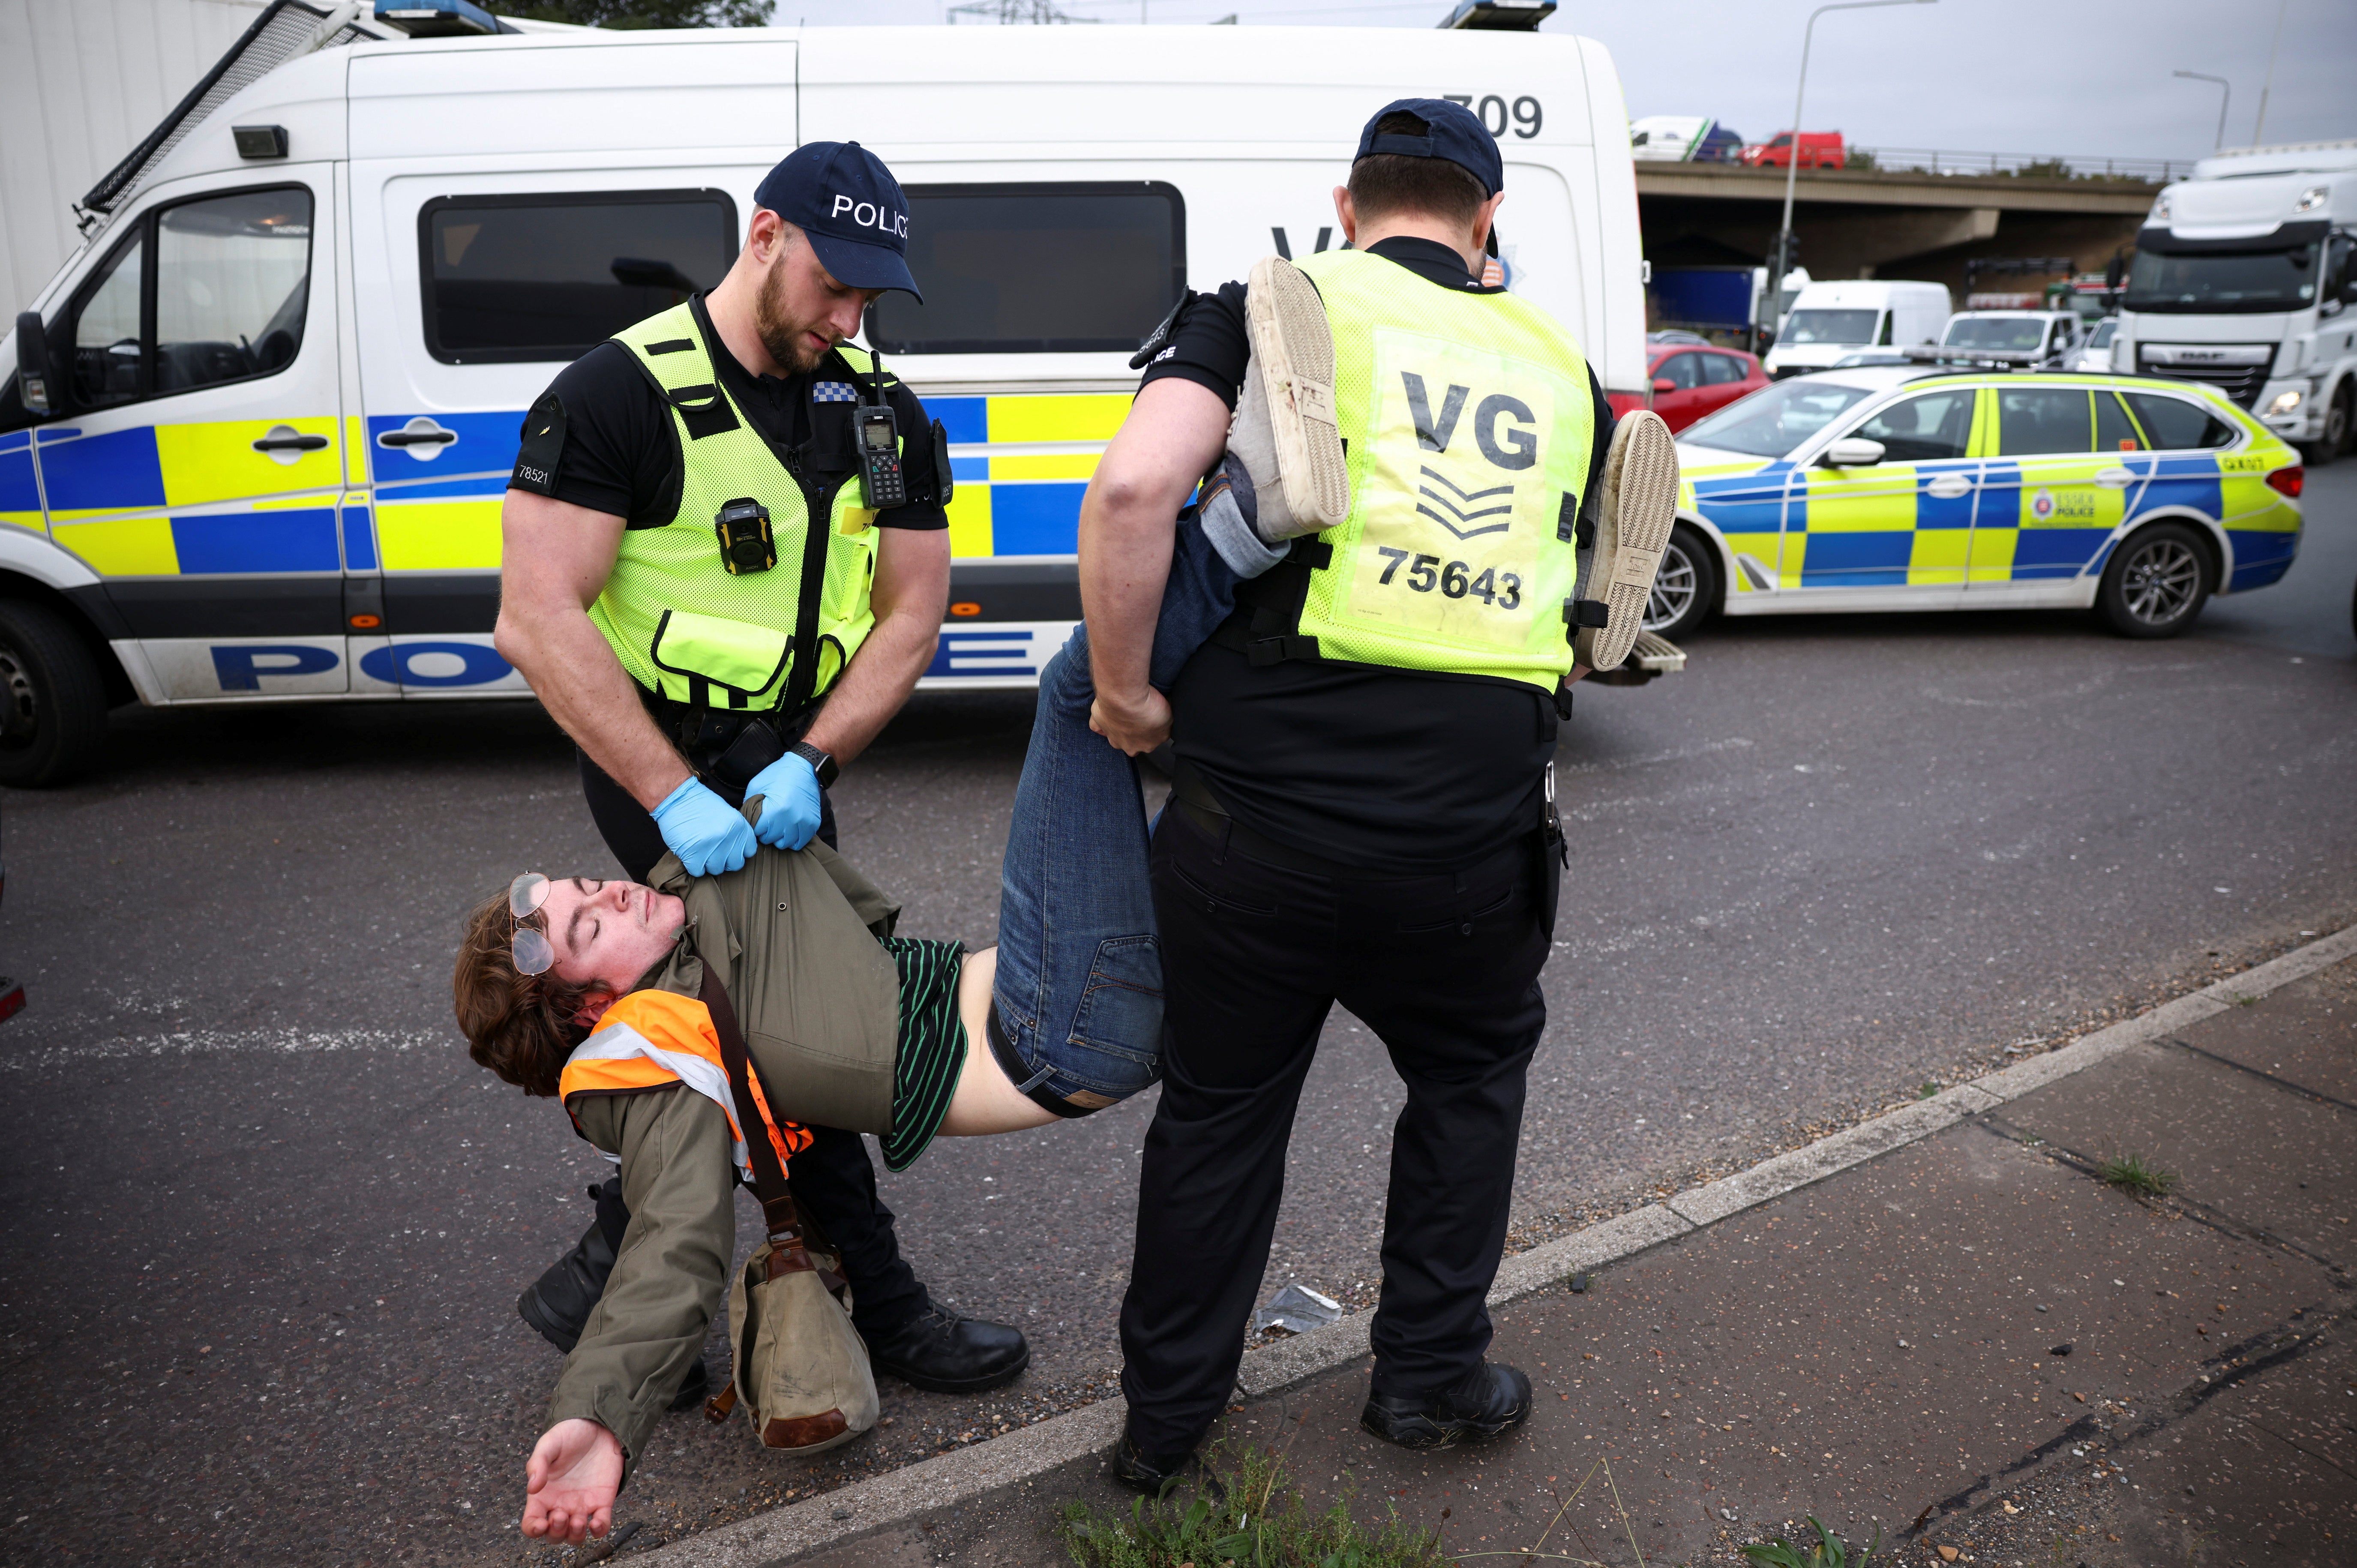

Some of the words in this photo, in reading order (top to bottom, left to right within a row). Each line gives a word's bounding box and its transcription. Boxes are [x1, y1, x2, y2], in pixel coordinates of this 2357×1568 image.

[1400, 370, 1537, 471] VG
[519, 465, 548, 485] 78521
[2057, 507, 2094, 518] POLICE
[1378, 546, 1521, 611] 75643
